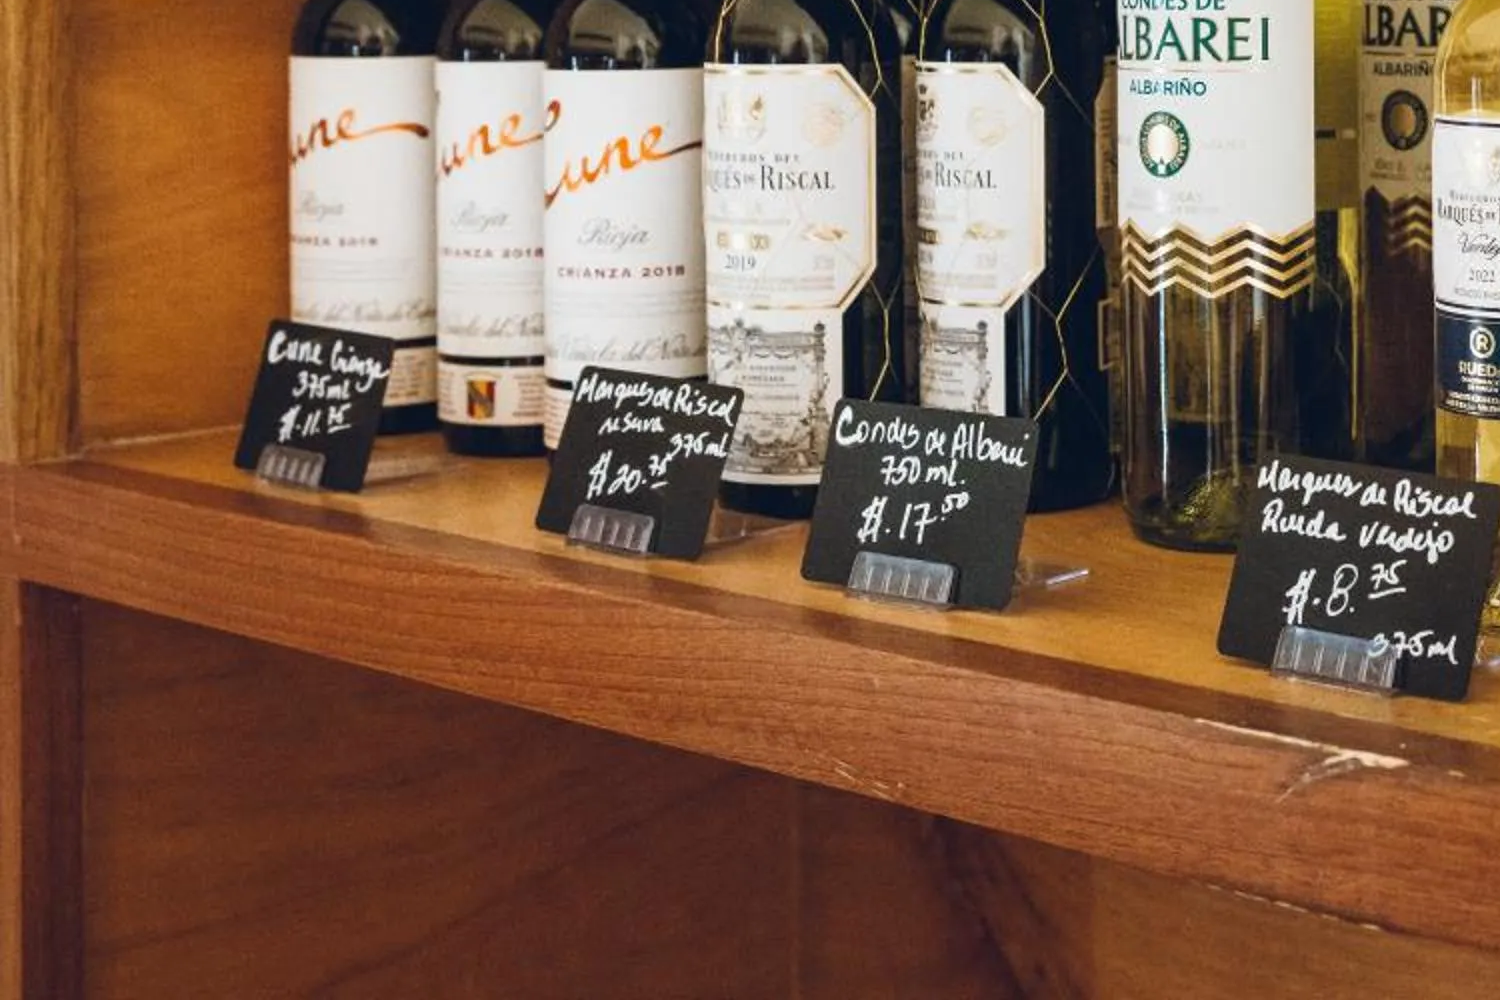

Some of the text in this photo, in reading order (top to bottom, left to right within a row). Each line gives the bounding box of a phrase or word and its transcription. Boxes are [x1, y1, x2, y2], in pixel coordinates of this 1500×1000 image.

[1119, 17, 1270, 62] LBAREI
[1364, 4, 1451, 47] LBAR
[1373, 60, 1434, 76] ALBARIÑ
[1129, 78, 1207, 96] ALBARIÑO
[291, 108, 429, 168] une
[439, 113, 544, 176] une
[761, 164, 836, 191] RISCAL
[935, 161, 998, 188] RISCAL
[577, 216, 651, 252] Rioja
[557, 264, 686, 280] CRIANZA 2018
[724, 254, 757, 271] 2019
[1468, 268, 1496, 283] 2022
[267, 329, 323, 365] Cune
[835, 405, 920, 450] Condes
[925, 427, 947, 457] de
[1257, 459, 1478, 519] Marques de Riscal
[1261, 498, 1347, 543] Rueda
